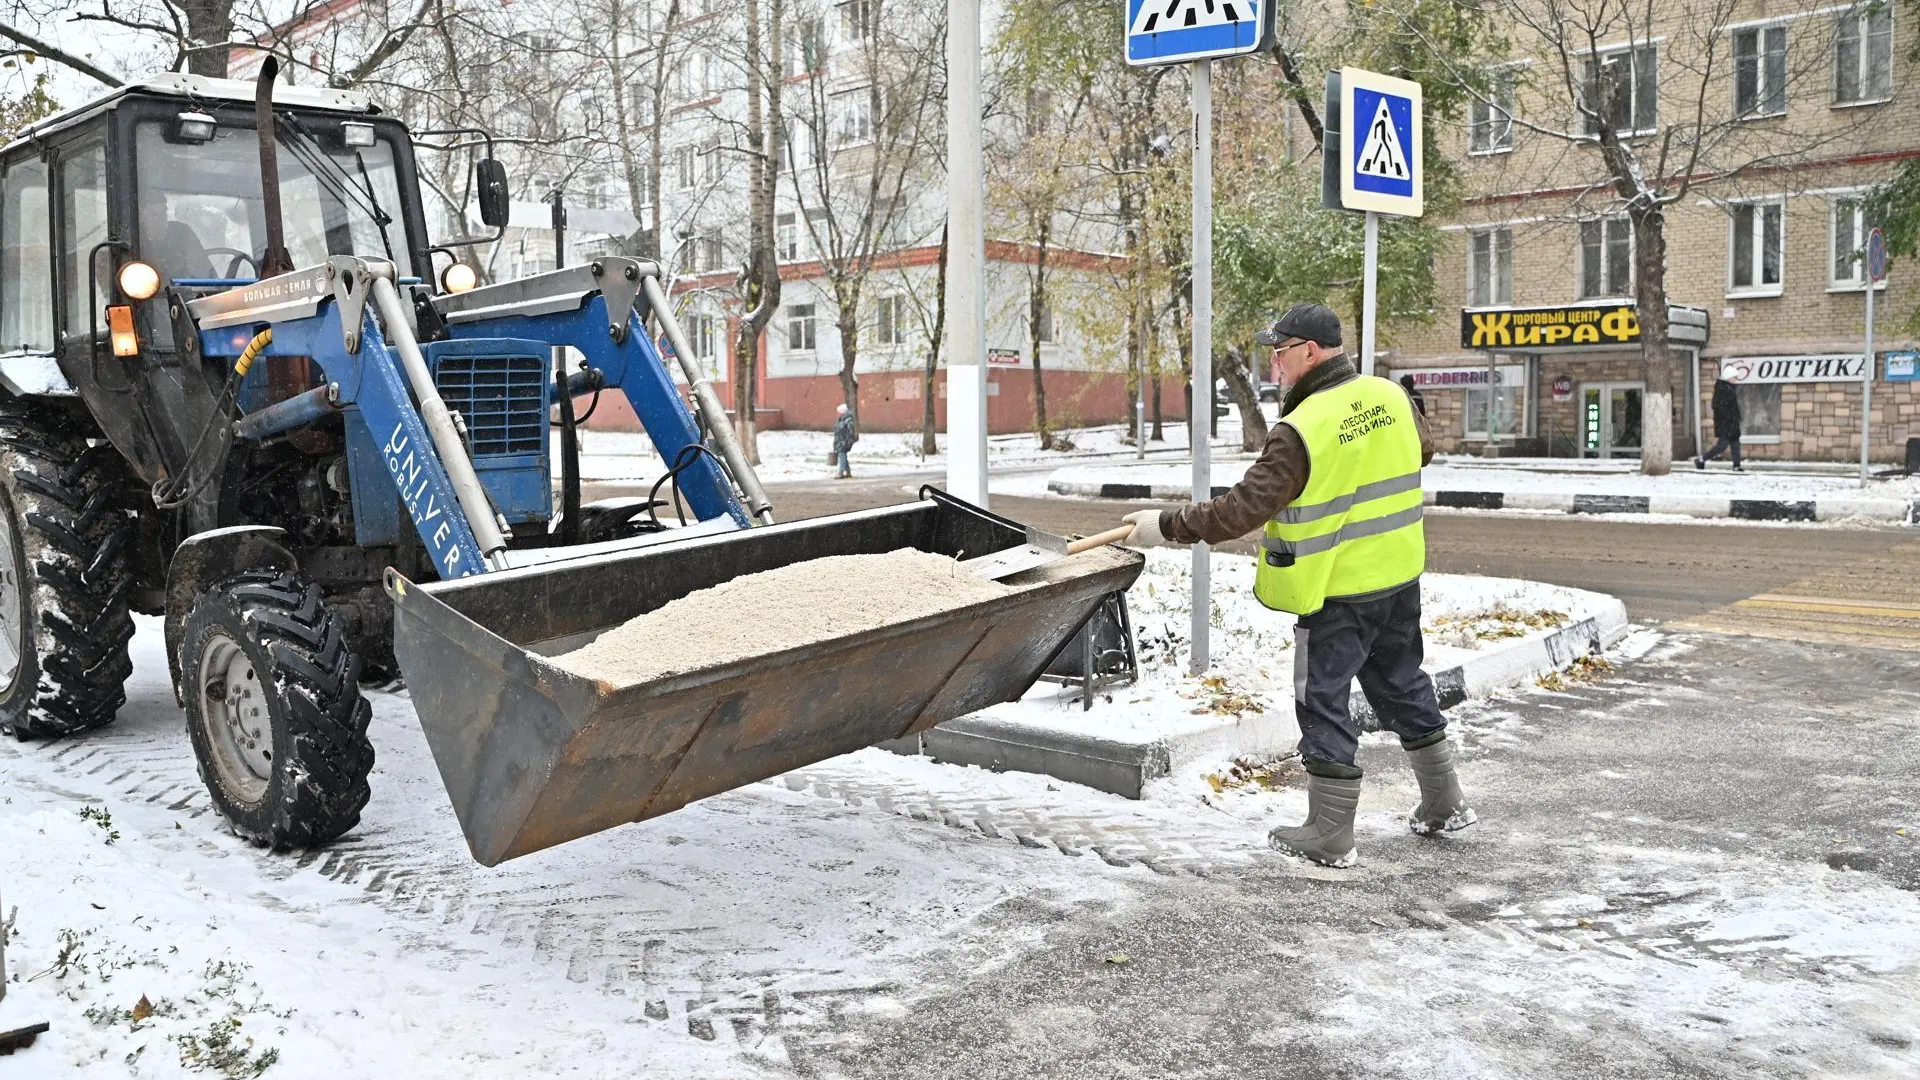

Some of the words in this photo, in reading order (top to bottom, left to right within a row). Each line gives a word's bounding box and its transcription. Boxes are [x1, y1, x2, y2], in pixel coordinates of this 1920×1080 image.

[243, 286, 281, 302] БОЛЬШАЯ
[1512, 311, 1565, 325] ТОРГОВЫЙ
[1568, 310, 1600, 324] ЦЕНТР
[1553, 380, 1570, 391] WB
[1350, 400, 1363, 412] МУ
[1338, 415, 1396, 445] ЛЫТКАИНО»
[383, 443, 423, 525] ROBUST
[390, 422, 471, 578] UNIVER
